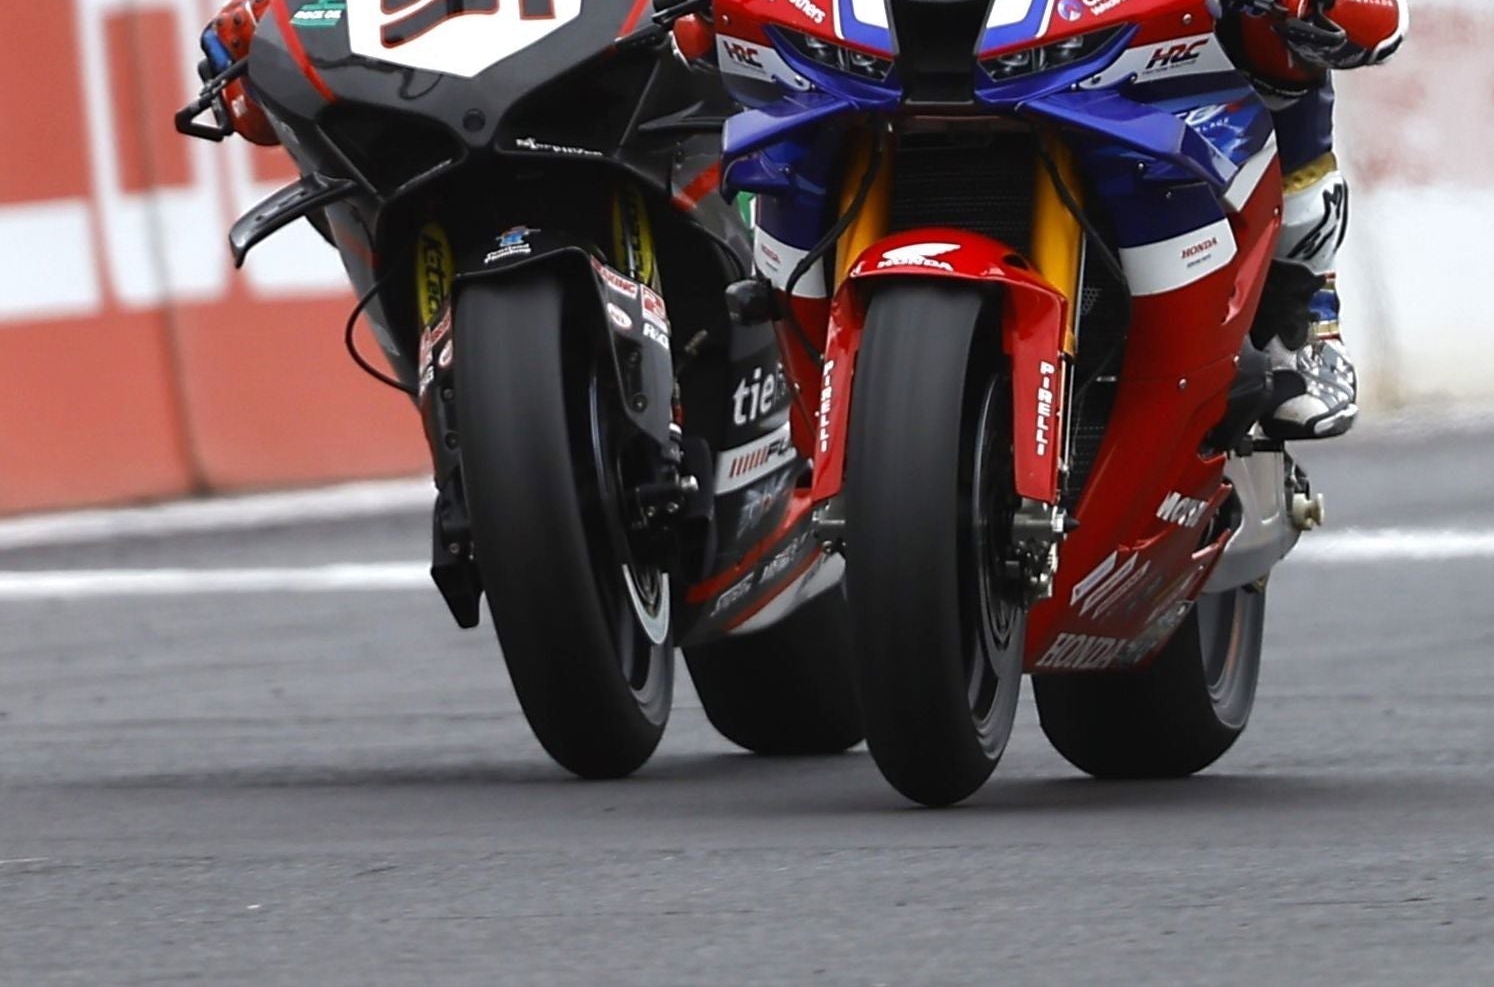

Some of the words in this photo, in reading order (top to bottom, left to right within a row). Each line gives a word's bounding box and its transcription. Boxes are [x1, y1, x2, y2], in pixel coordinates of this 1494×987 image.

[722, 39, 763, 68] HRC
[1145, 38, 1210, 69] HRC
[1181, 236, 1218, 259] HONDA
[877, 257, 954, 272] HONDA
[819, 360, 835, 453] PIRELLI
[1035, 360, 1056, 456] PIRELLI
